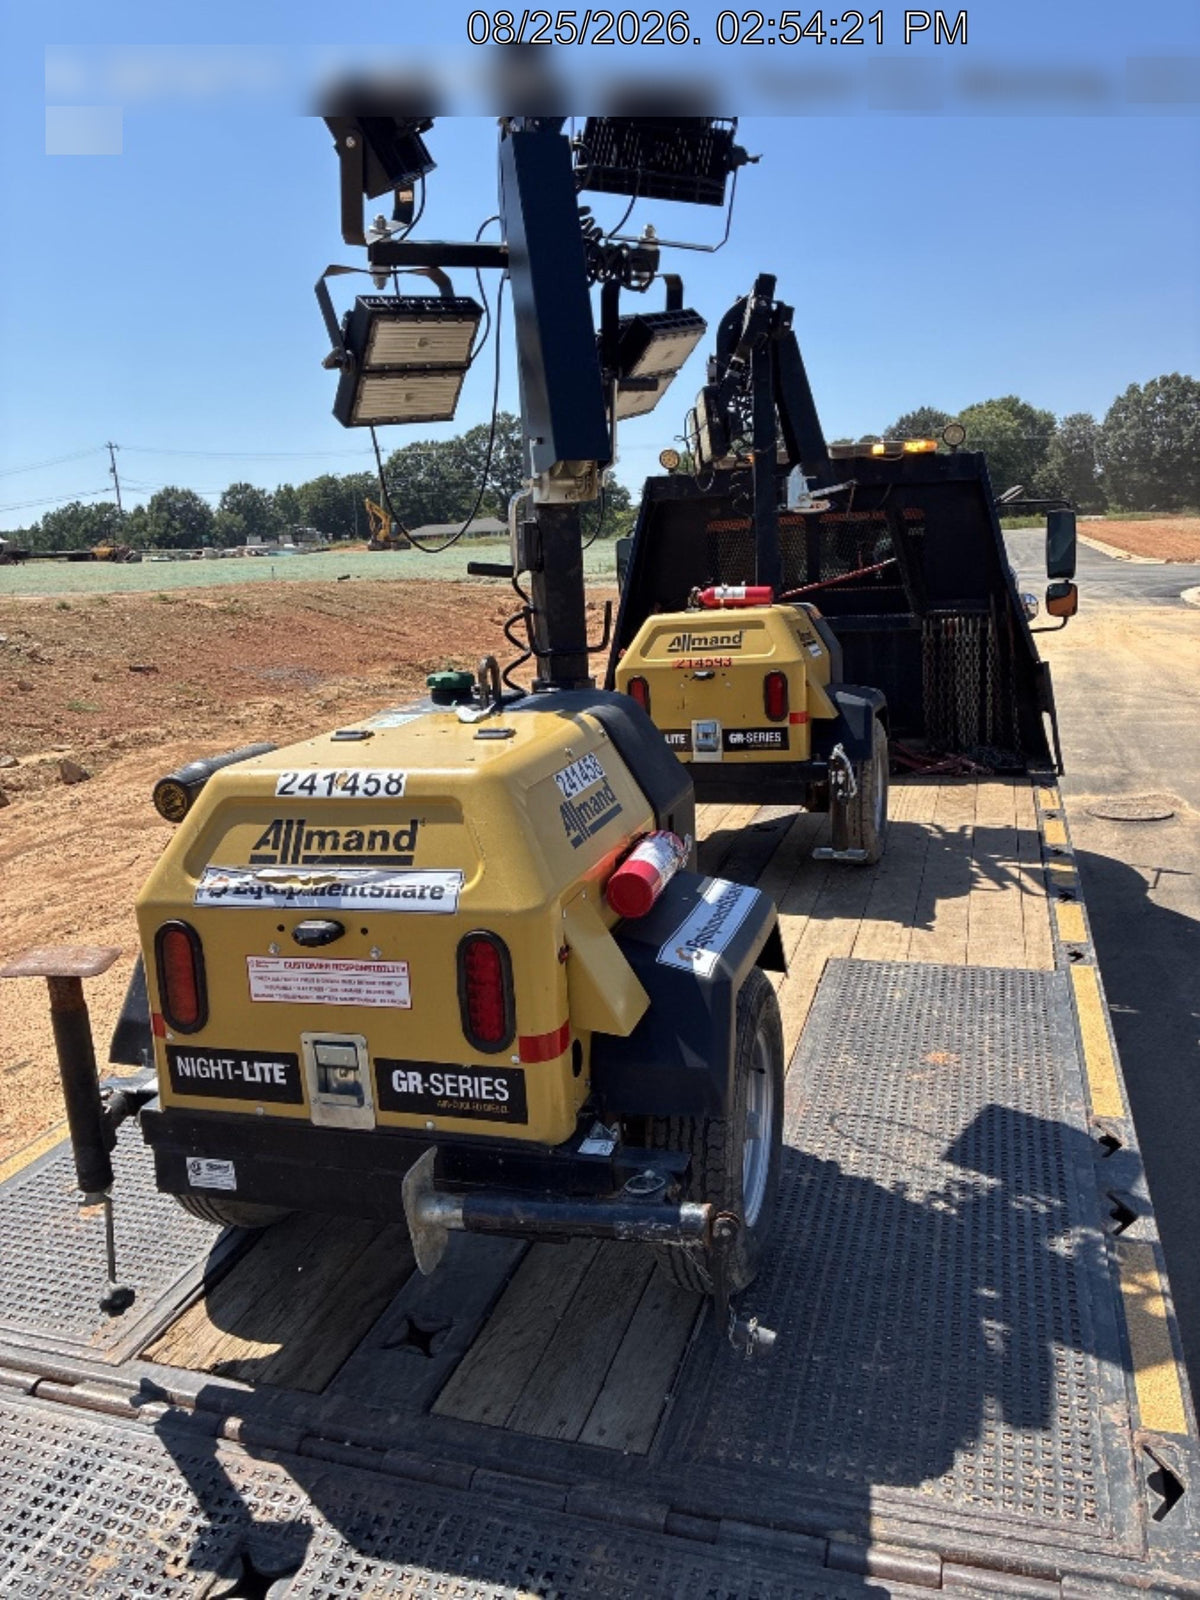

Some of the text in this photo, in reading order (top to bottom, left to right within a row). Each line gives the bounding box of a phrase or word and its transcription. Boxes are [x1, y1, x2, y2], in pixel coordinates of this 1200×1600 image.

[667, 631, 743, 652] Allmand
[729, 732, 782, 744] GR-SERIES
[276, 771, 405, 797] 241458
[555, 754, 604, 798] 241458
[560, 777, 619, 844] Allmand
[250, 818, 419, 865] Allmand
[176, 1056, 287, 1085] NIGHT-LITE
[391, 1069, 510, 1102] GR-SERIES
